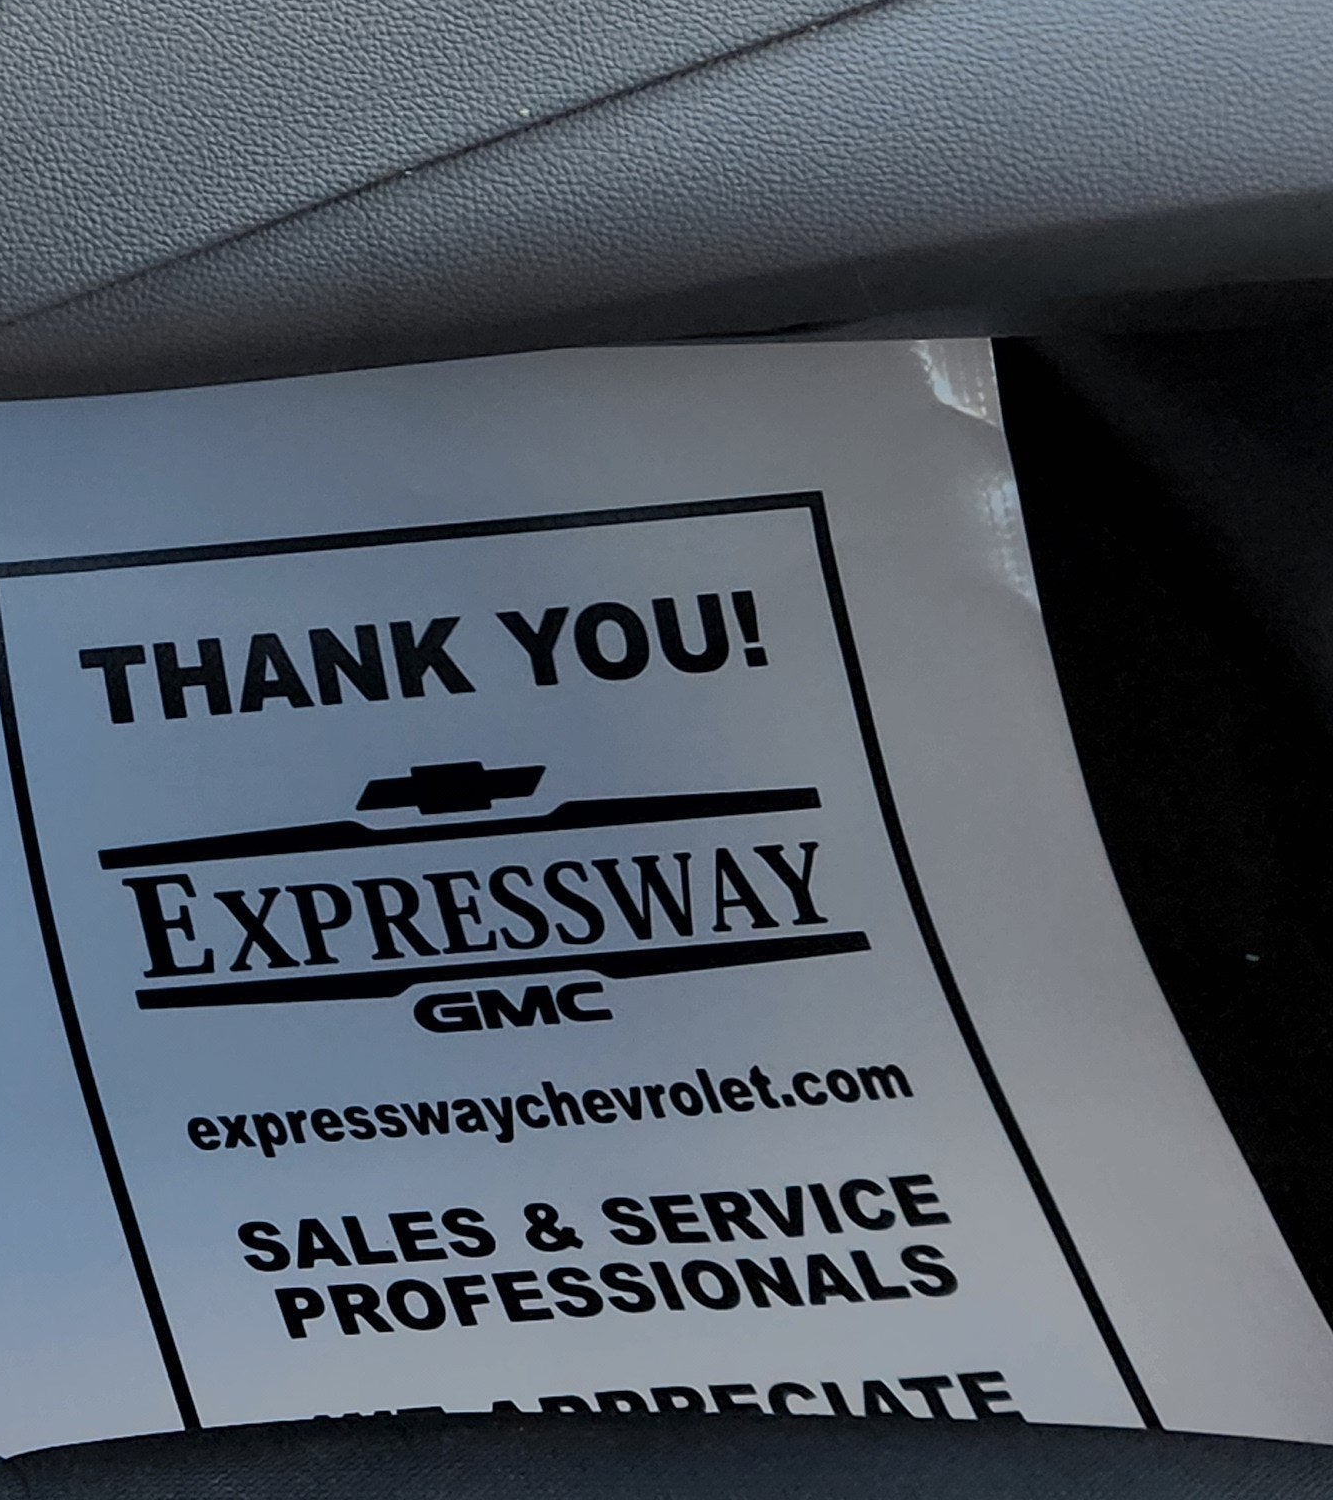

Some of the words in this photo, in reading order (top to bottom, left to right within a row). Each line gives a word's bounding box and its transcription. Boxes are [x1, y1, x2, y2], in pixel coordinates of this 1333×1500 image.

[79, 615, 476, 726] THANK
[497, 590, 769, 688] YOU!
[122, 841, 829, 980] EXPRESSWAY
[413, 981, 613, 1034] GMC
[187, 1061, 913, 1158] expresswaychevrolet.com
[238, 1206, 497, 1274] SALES
[525, 1200, 584, 1254] &
[600, 1172, 951, 1246] SERVICE
[274, 1243, 959, 1340] PROFESSIONALS
